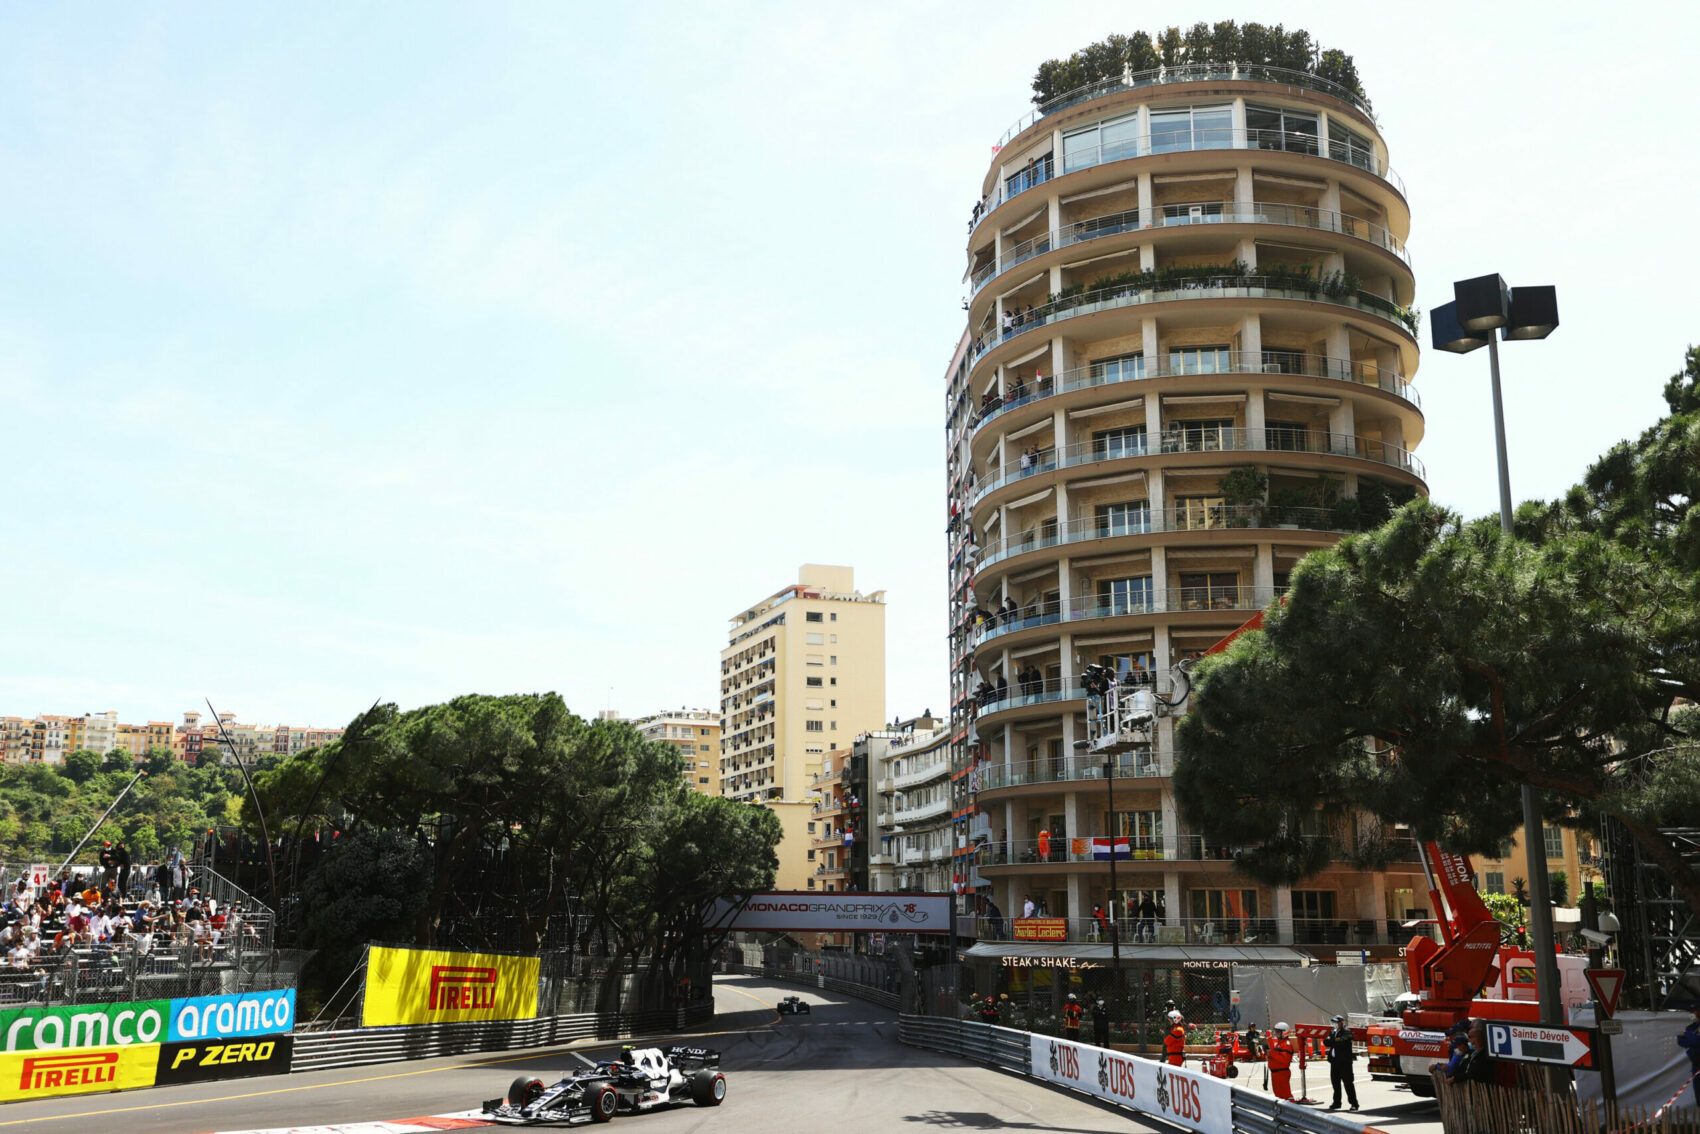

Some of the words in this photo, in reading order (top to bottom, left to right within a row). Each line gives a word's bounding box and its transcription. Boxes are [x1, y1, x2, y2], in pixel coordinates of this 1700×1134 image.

[1002, 956, 1032, 967] STEAK
[1041, 957, 1077, 968] SHAKE
[1183, 961, 1211, 969] MONTE
[428, 965, 497, 1010] PIRELLI
[0, 1009, 162, 1050] ramco
[177, 997, 290, 1038] aramco
[1512, 1028, 1538, 1040] Sainte
[1540, 1030, 1570, 1042] Dévote
[19, 1052, 119, 1090] PIRELLI
[171, 1048, 196, 1069] P
[199, 1041, 276, 1066] ZERO
[1058, 1044, 1079, 1081] UBS
[1108, 1057, 1135, 1099] UBS
[1168, 1073, 1201, 1123] UBS
